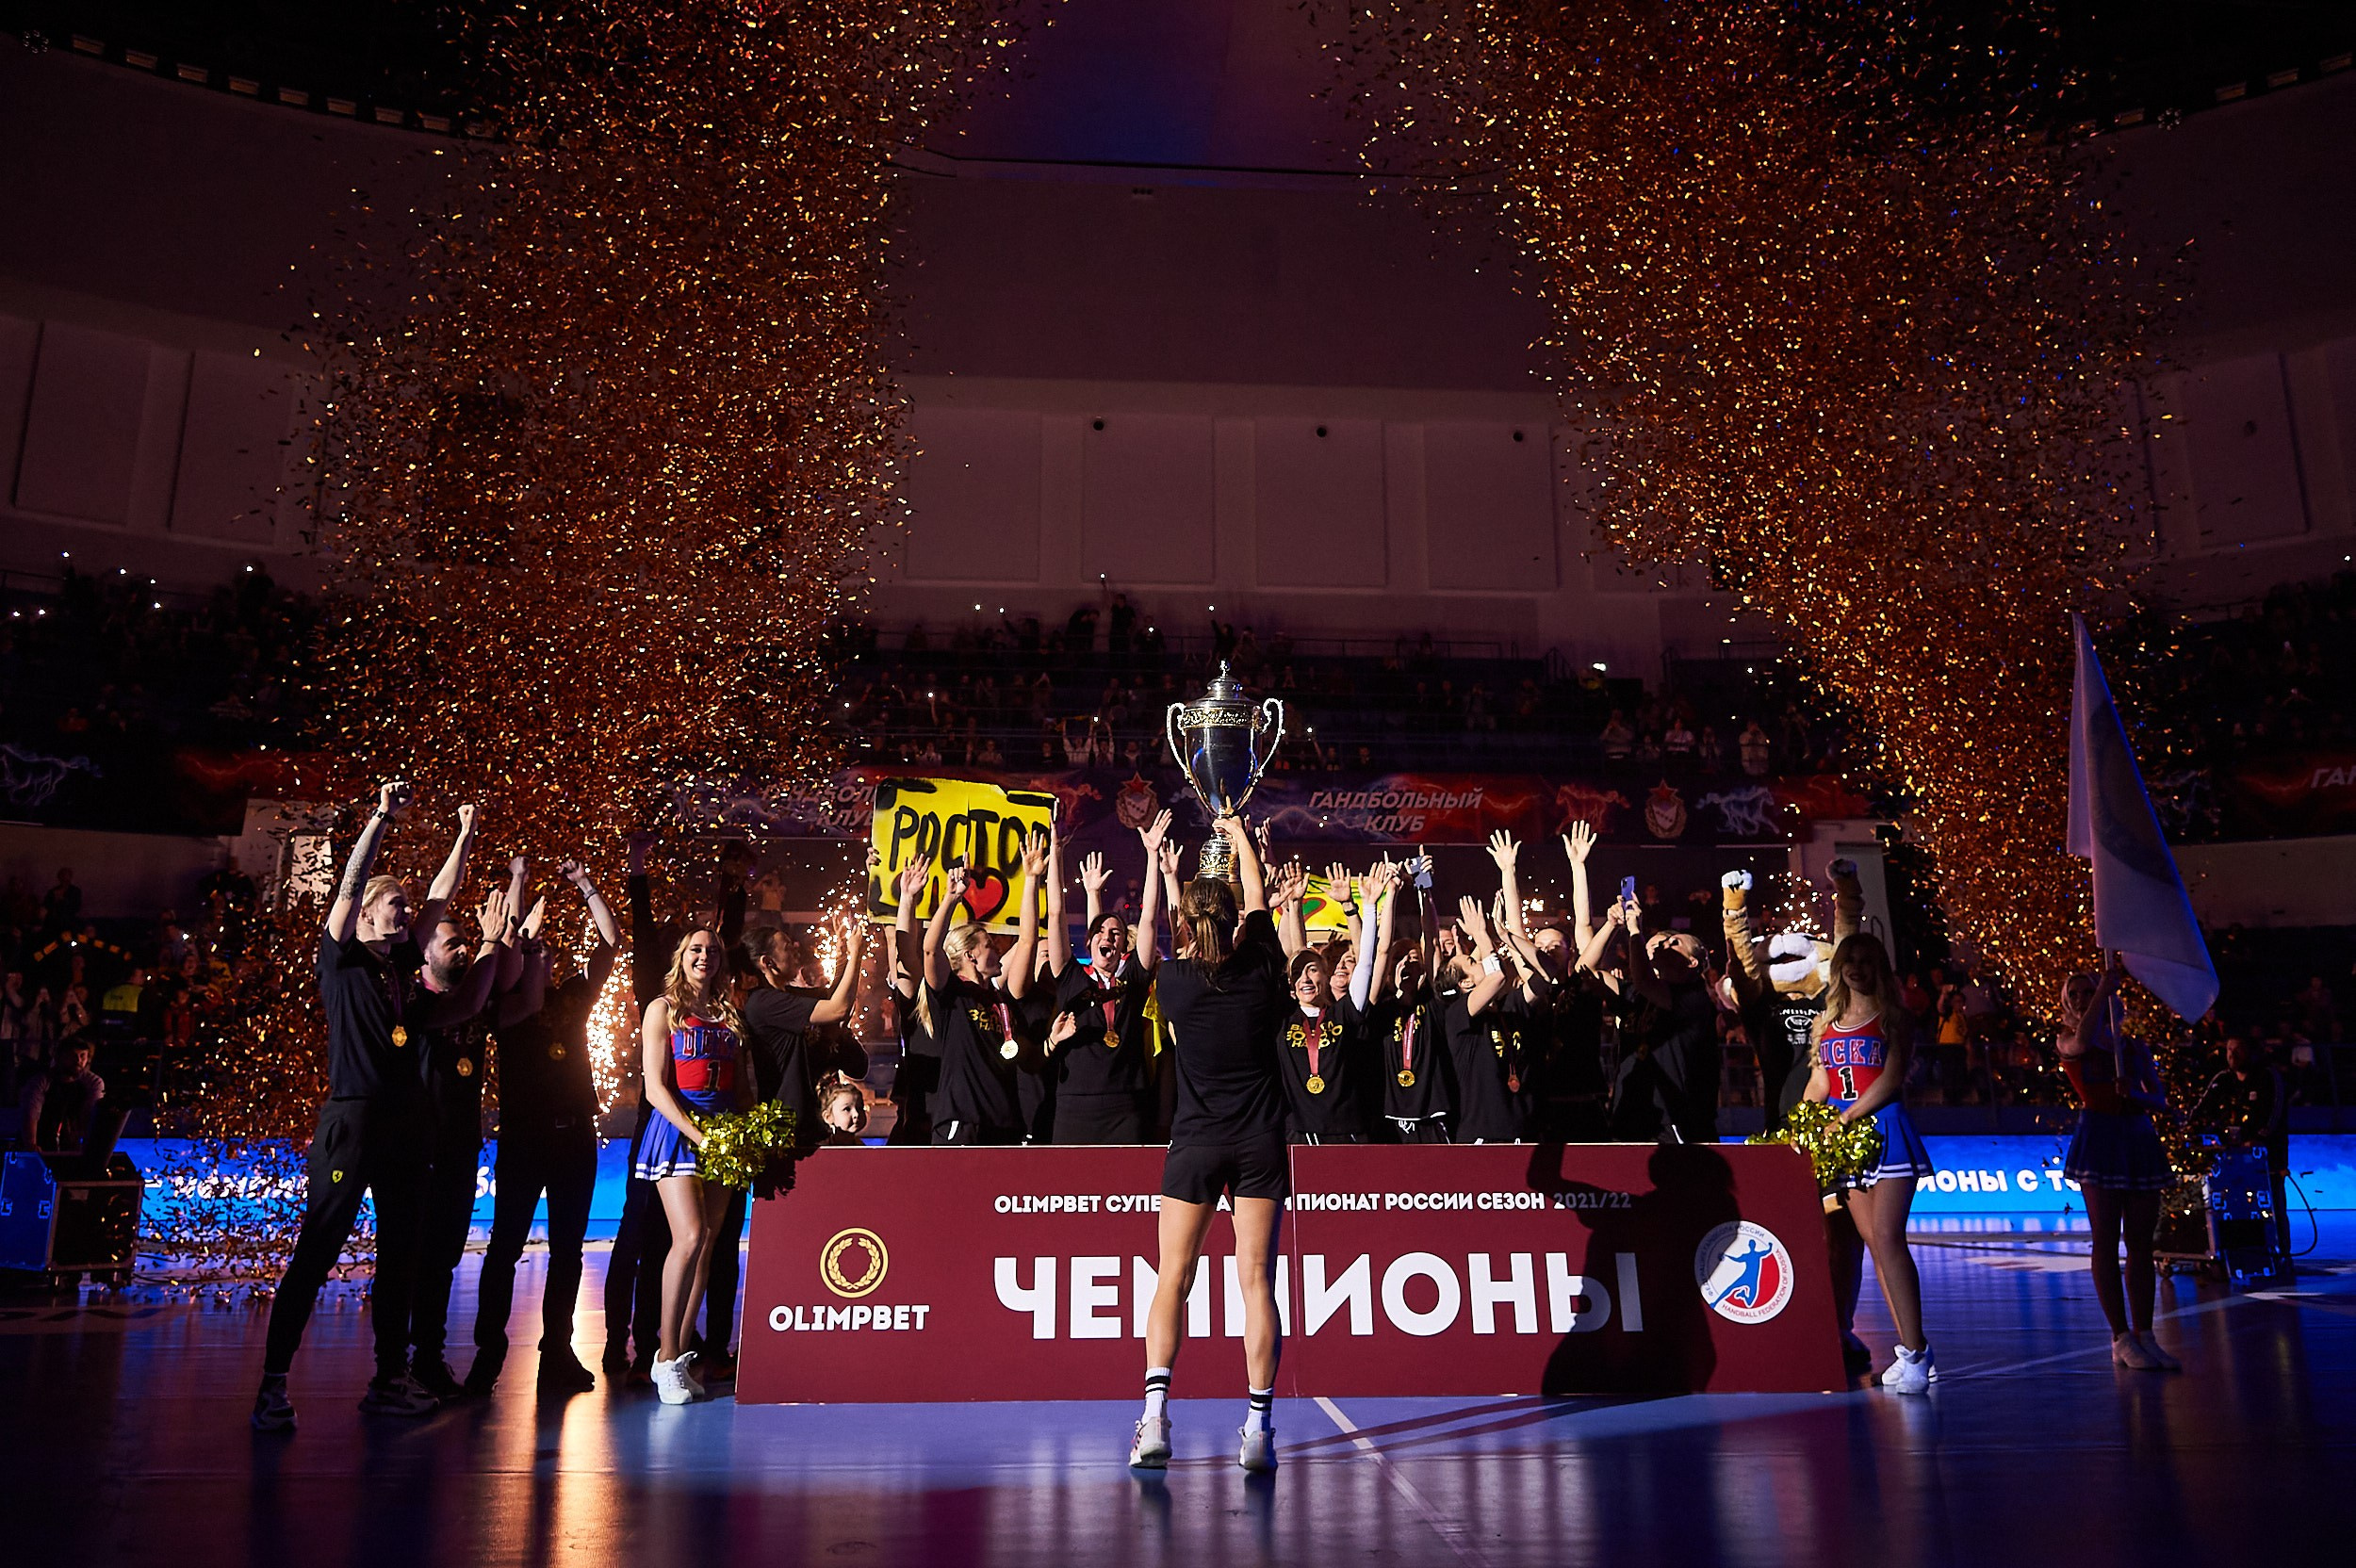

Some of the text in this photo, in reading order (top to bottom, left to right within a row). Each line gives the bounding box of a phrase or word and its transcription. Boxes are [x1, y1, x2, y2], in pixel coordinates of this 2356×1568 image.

[1308, 787, 1483, 809] ГАНДБОЛЬНЫЙ
[1363, 814, 1425, 832] КЛУБ
[1839, 1066, 1859, 1102] 1
[993, 1195, 1101, 1214] OLIMPBET
[1384, 1192, 1474, 1212] РОССИИ
[1476, 1192, 1546, 1211] СЕЗОН
[1553, 1191, 1632, 1210] 2021/22
[1722, 1303, 1758, 1318] HANDBALL
[1758, 1284, 1788, 1316] FEDERATION
[1775, 1249, 1789, 1275] RUSSIA
[768, 1304, 930, 1332] OLIMPBET
